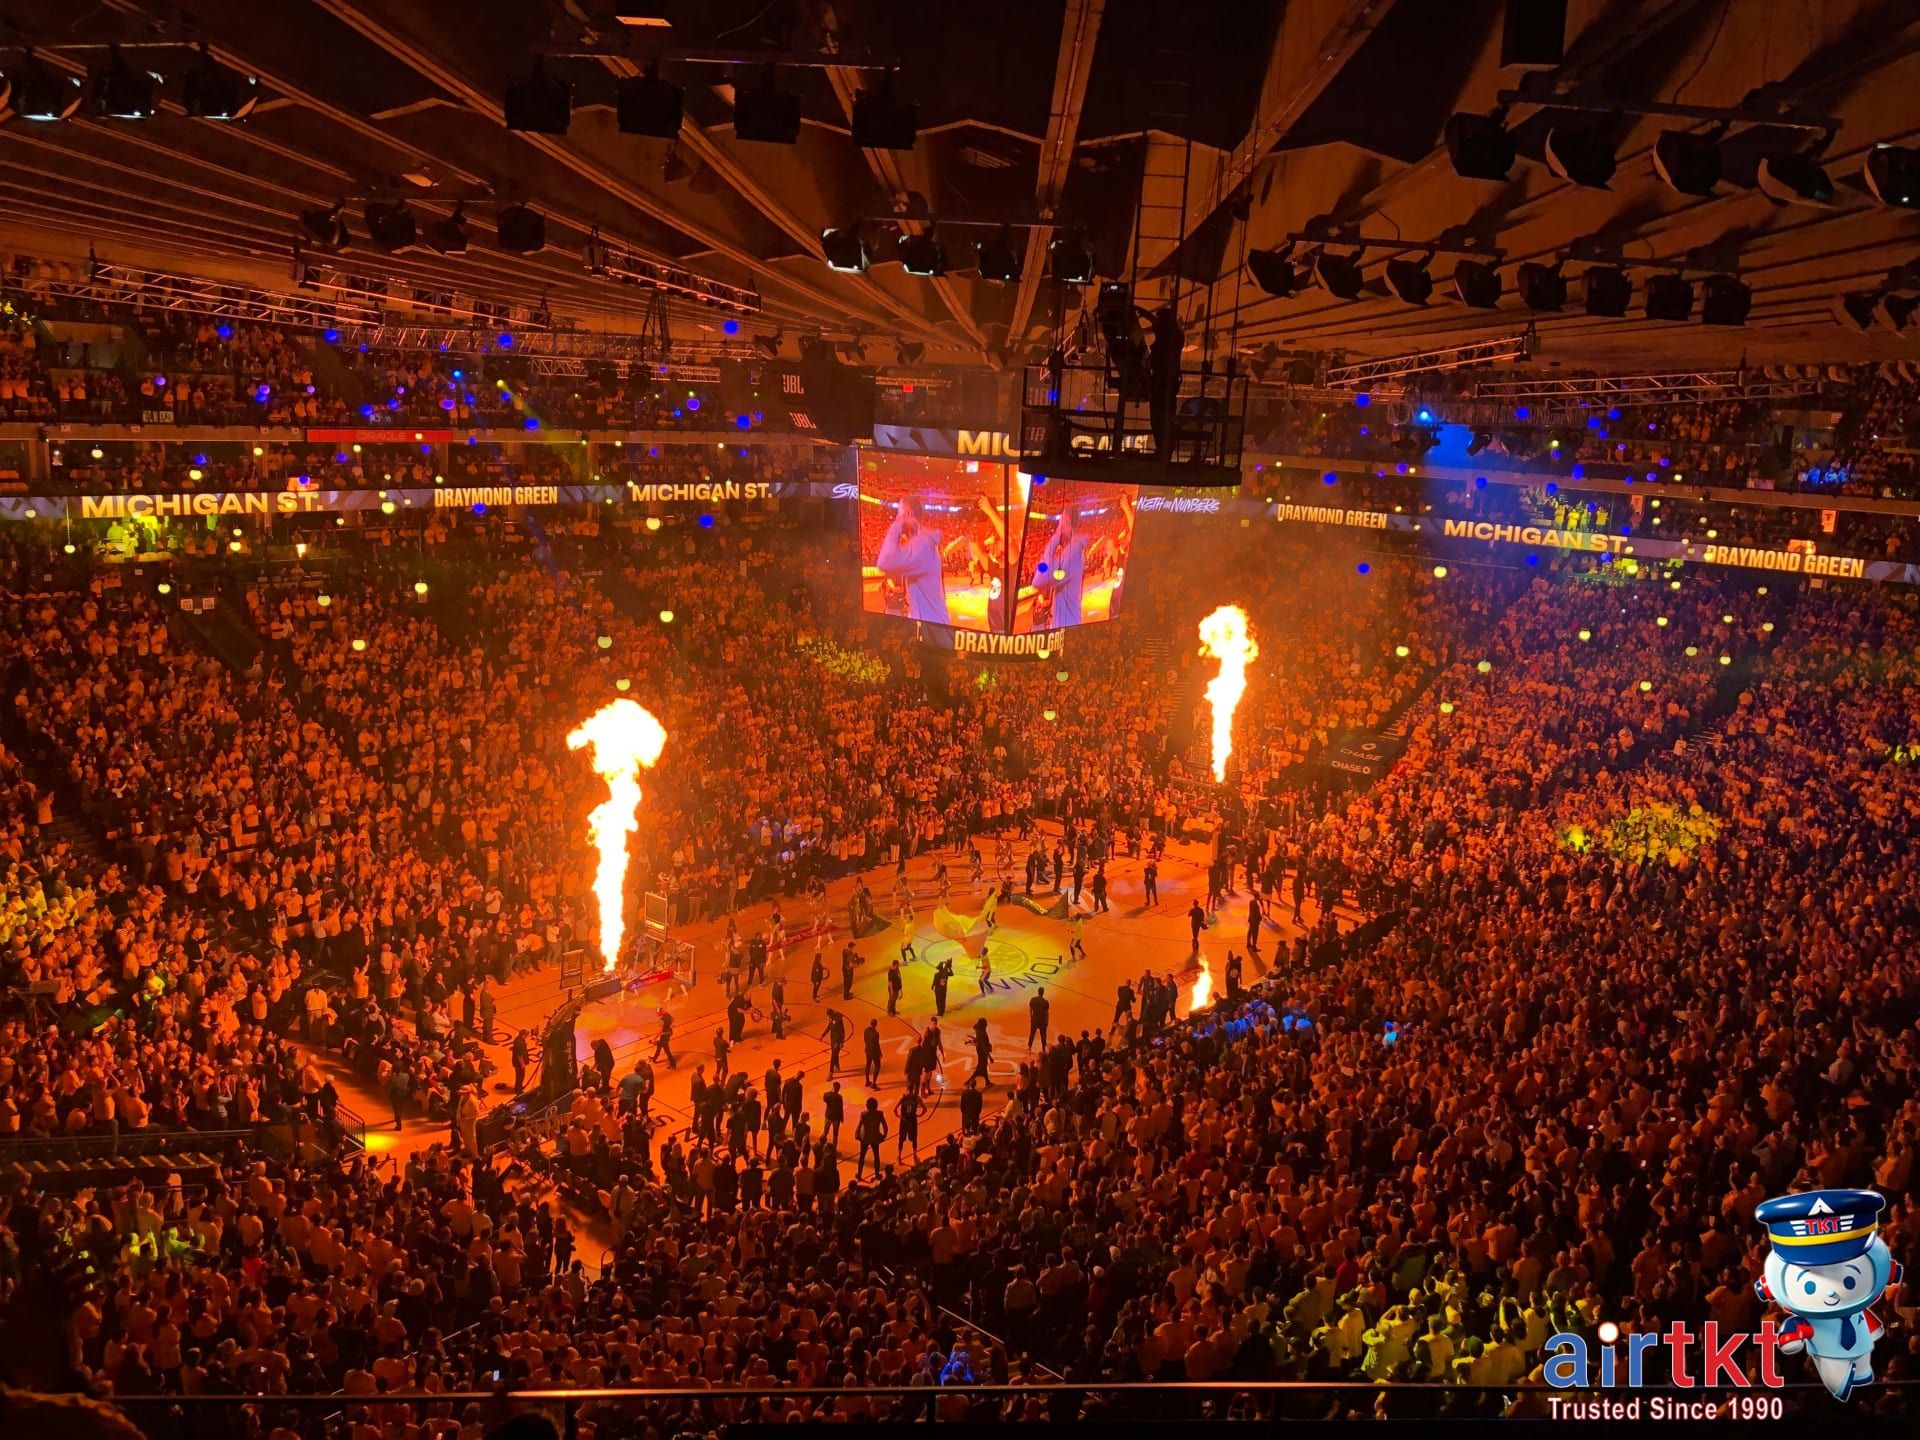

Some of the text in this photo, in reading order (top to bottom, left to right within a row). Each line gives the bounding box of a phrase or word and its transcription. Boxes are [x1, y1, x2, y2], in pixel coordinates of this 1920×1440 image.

[782, 374, 804, 394] JBL
[789, 412, 817, 429] JBL
[356, 431, 408, 441] ORACLE
[434, 486, 558, 507] DRAYMOND GREEN
[632, 483, 773, 502] MICHIGAN ST.
[82, 491, 324, 518] MICHIGAN ST.
[1277, 503, 1388, 529] DRAYMOND GREEN
[1444, 519, 1583, 549] MICHIGAN
[1705, 544, 1865, 578] DRAYMOND GREEN
[954, 630, 1045, 655] DRAYMOND
[1340, 748, 1383, 761] CHASE
[1331, 760, 1362, 773] CHASE
